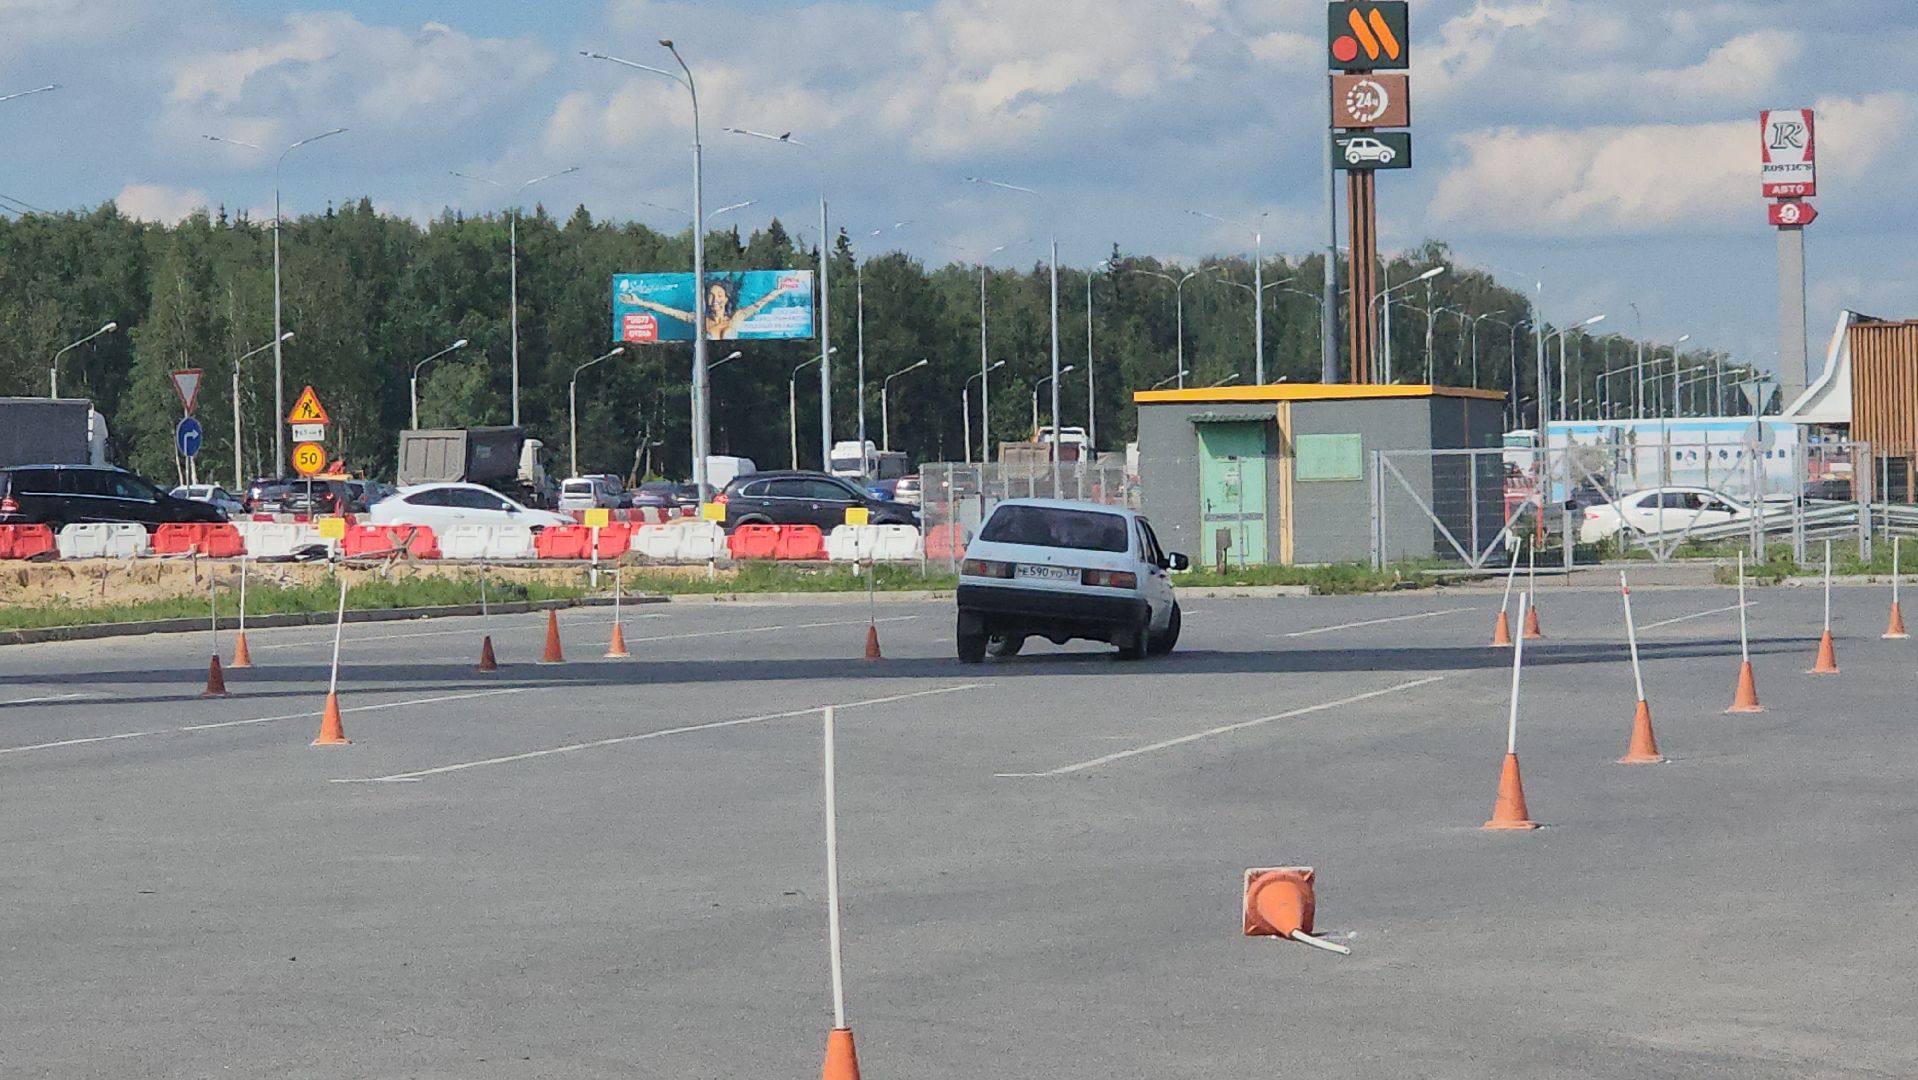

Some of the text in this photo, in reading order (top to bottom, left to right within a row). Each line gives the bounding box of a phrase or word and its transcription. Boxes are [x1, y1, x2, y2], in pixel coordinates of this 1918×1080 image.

[1769, 121, 1804, 149] R
[1772, 184, 1805, 194] АВТО
[300, 452, 318, 465] 50
